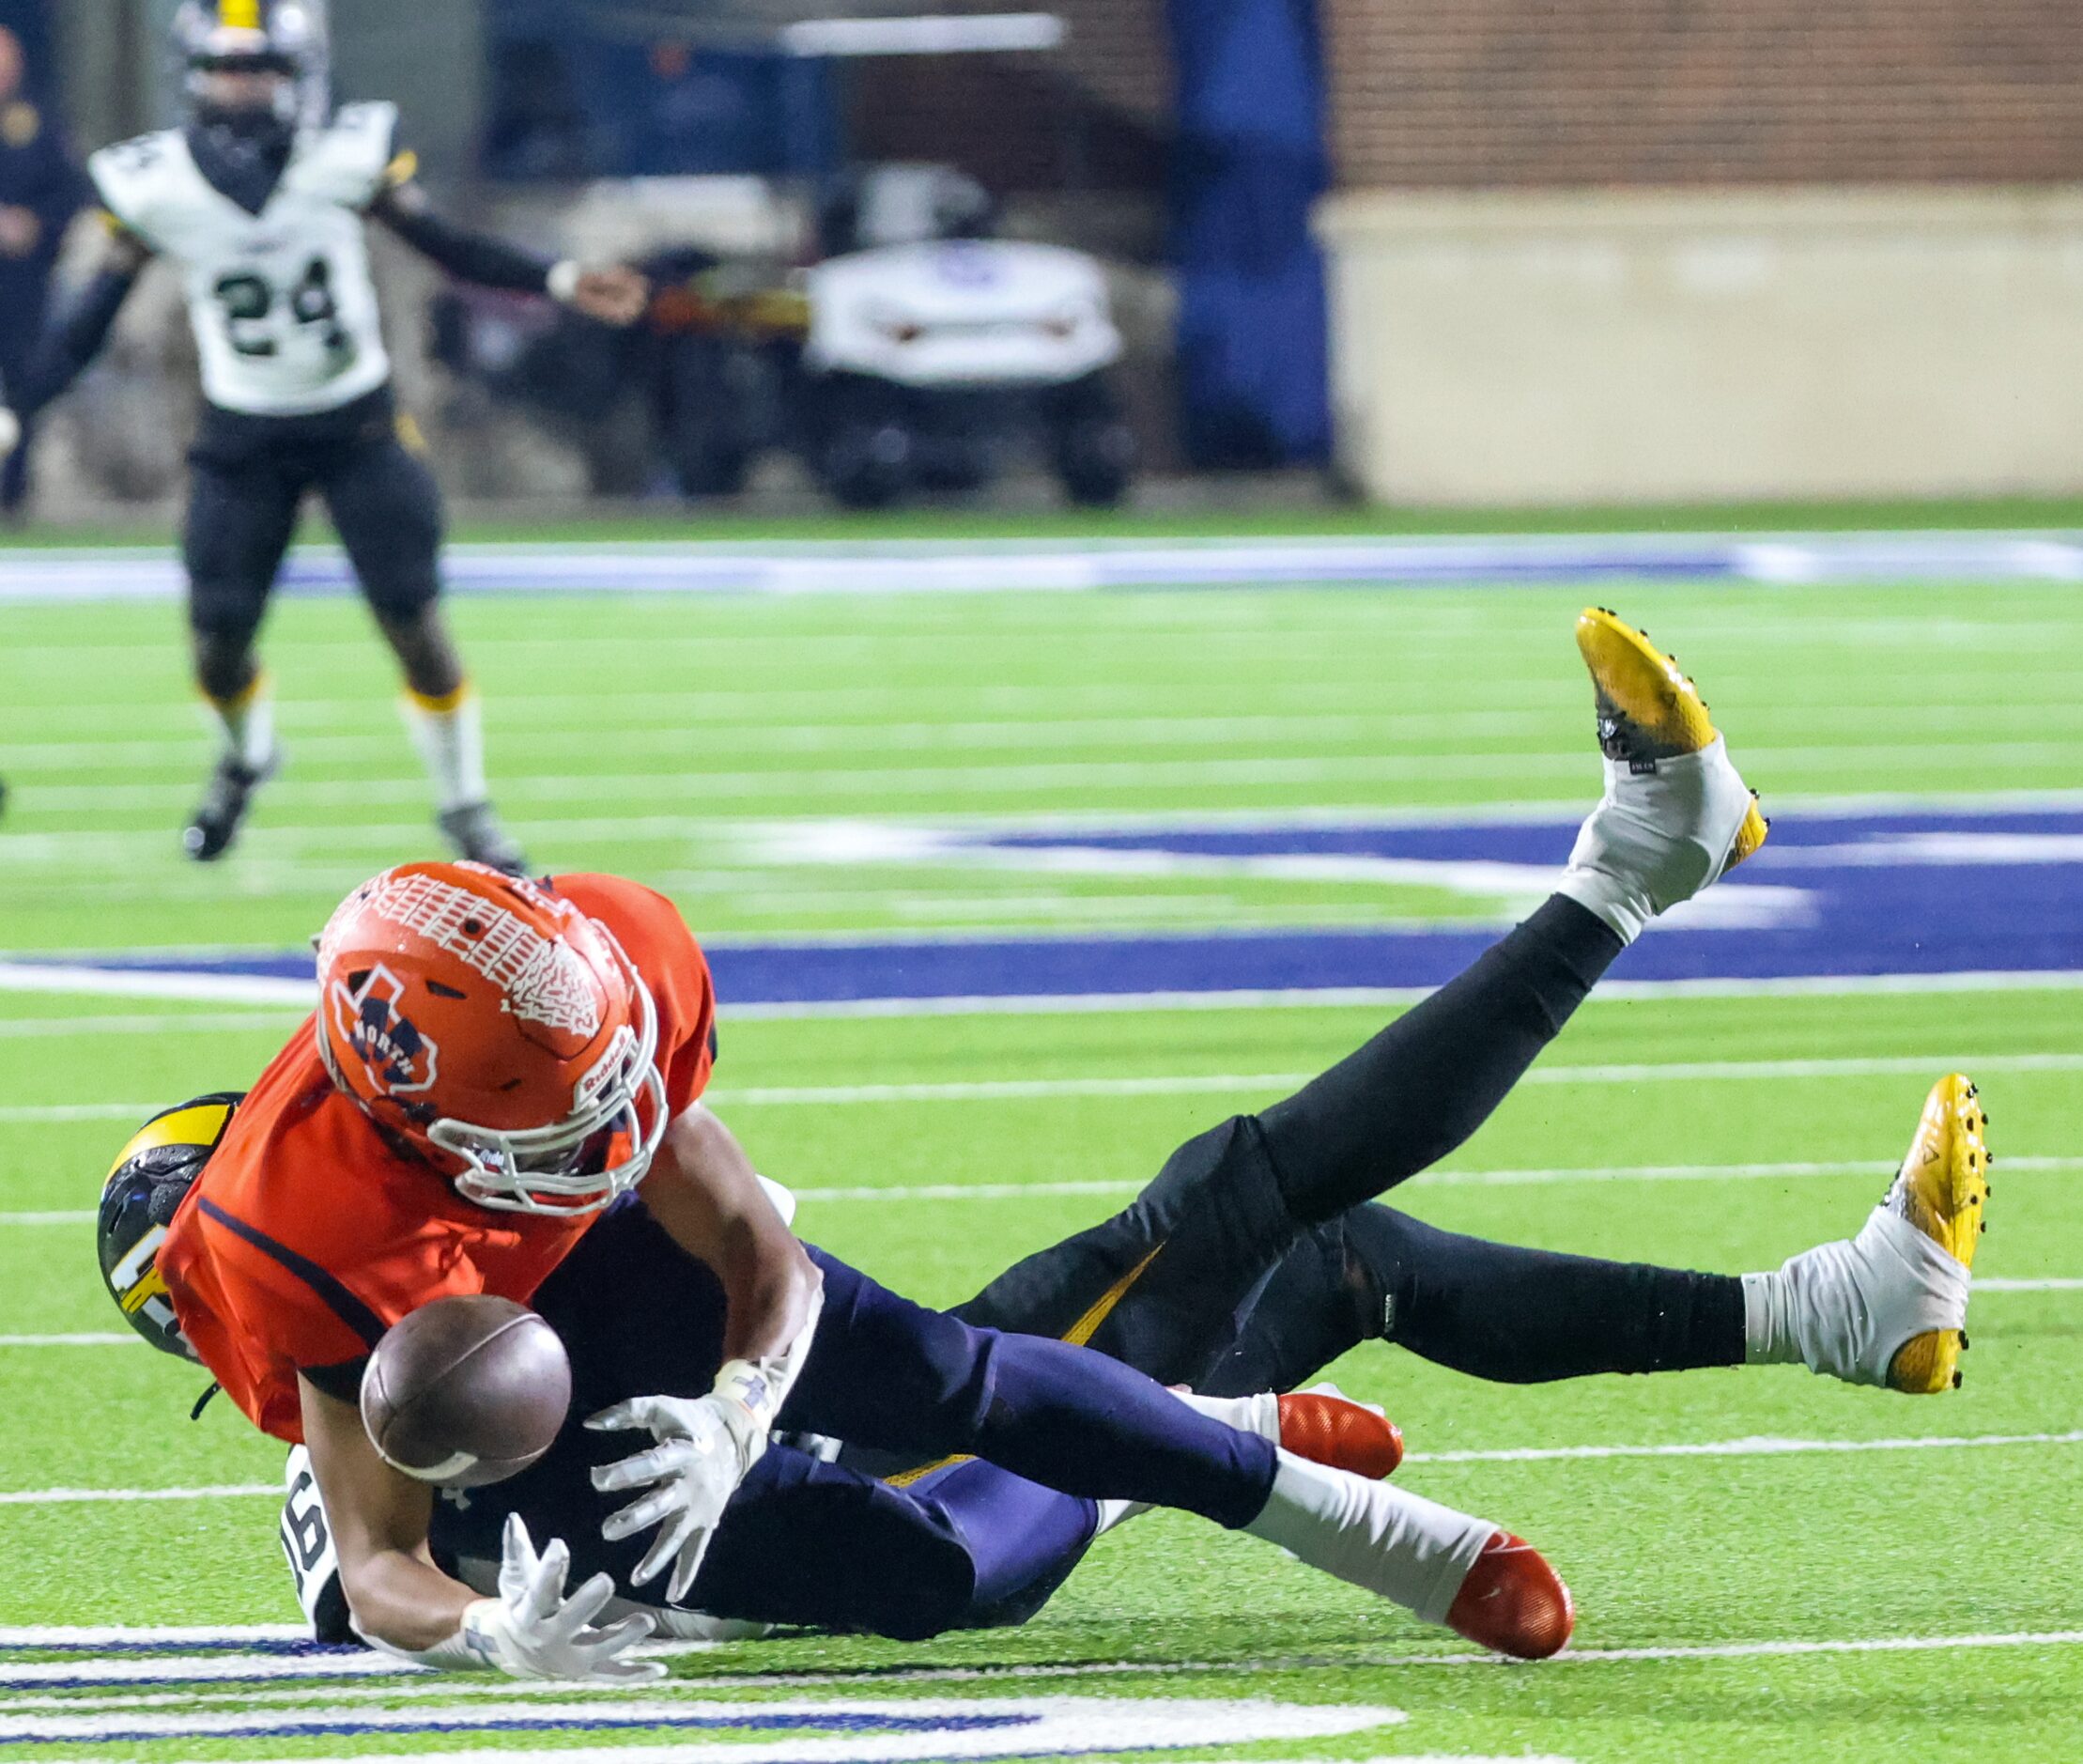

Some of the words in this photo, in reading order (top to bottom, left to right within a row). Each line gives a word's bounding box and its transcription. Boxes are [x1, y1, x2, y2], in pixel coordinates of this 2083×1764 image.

[215, 258, 347, 356] 24
[353, 1019, 415, 1075] NORTH
[281, 1470, 328, 1598] 6
